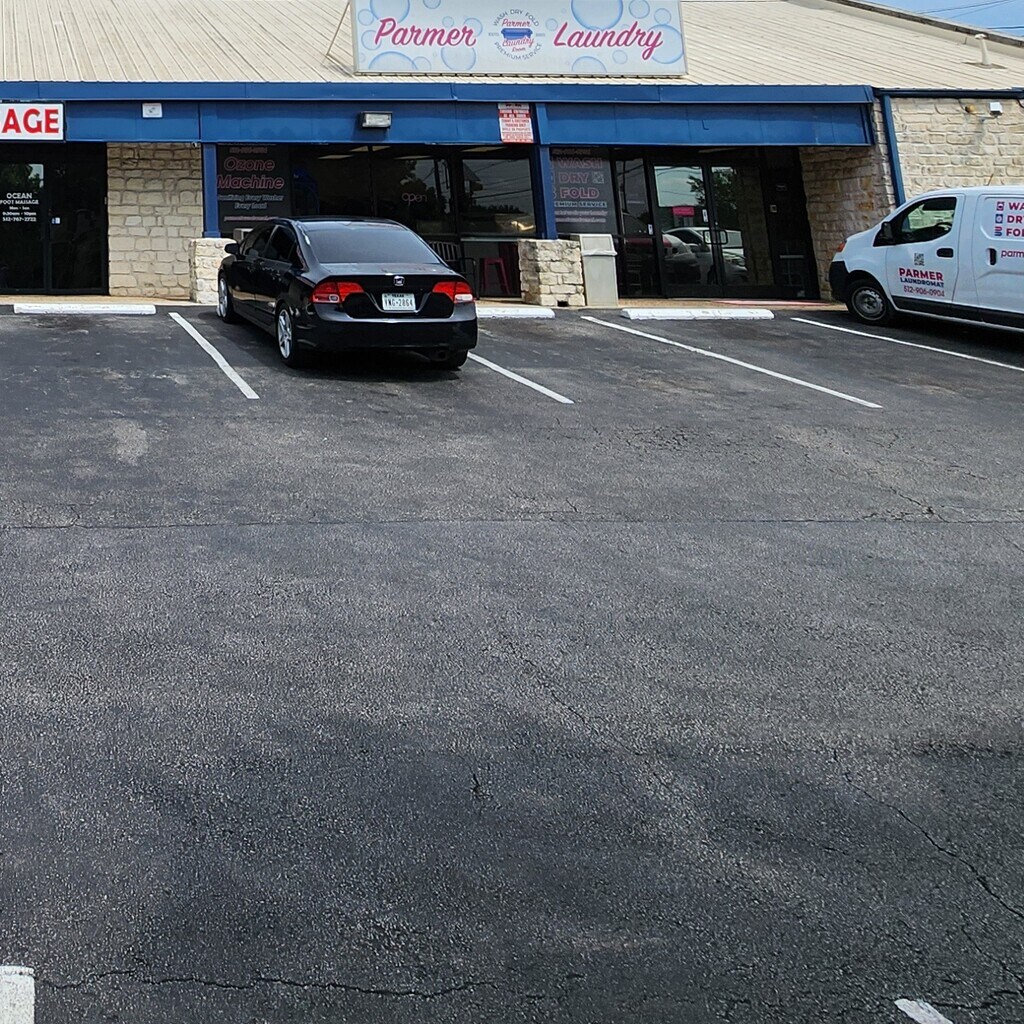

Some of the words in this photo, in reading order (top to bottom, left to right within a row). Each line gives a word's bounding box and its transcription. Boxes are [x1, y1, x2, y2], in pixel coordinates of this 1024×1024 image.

[525, 12, 539, 26] FOLD
[375, 18, 477, 47] Parmer
[553, 21, 664, 60] Laundry
[224, 156, 276, 172] Ozone
[558, 157, 603, 169] WASH
[217, 174, 285, 190] Machine
[558, 171, 590, 184] DRY
[560, 186, 600, 199] FOLD
[1007, 215, 1024, 224] DR
[1006, 228, 1024, 237] FO
[898, 267, 944, 281] PARMER
[900, 277, 944, 288] LAUNDROMAT
